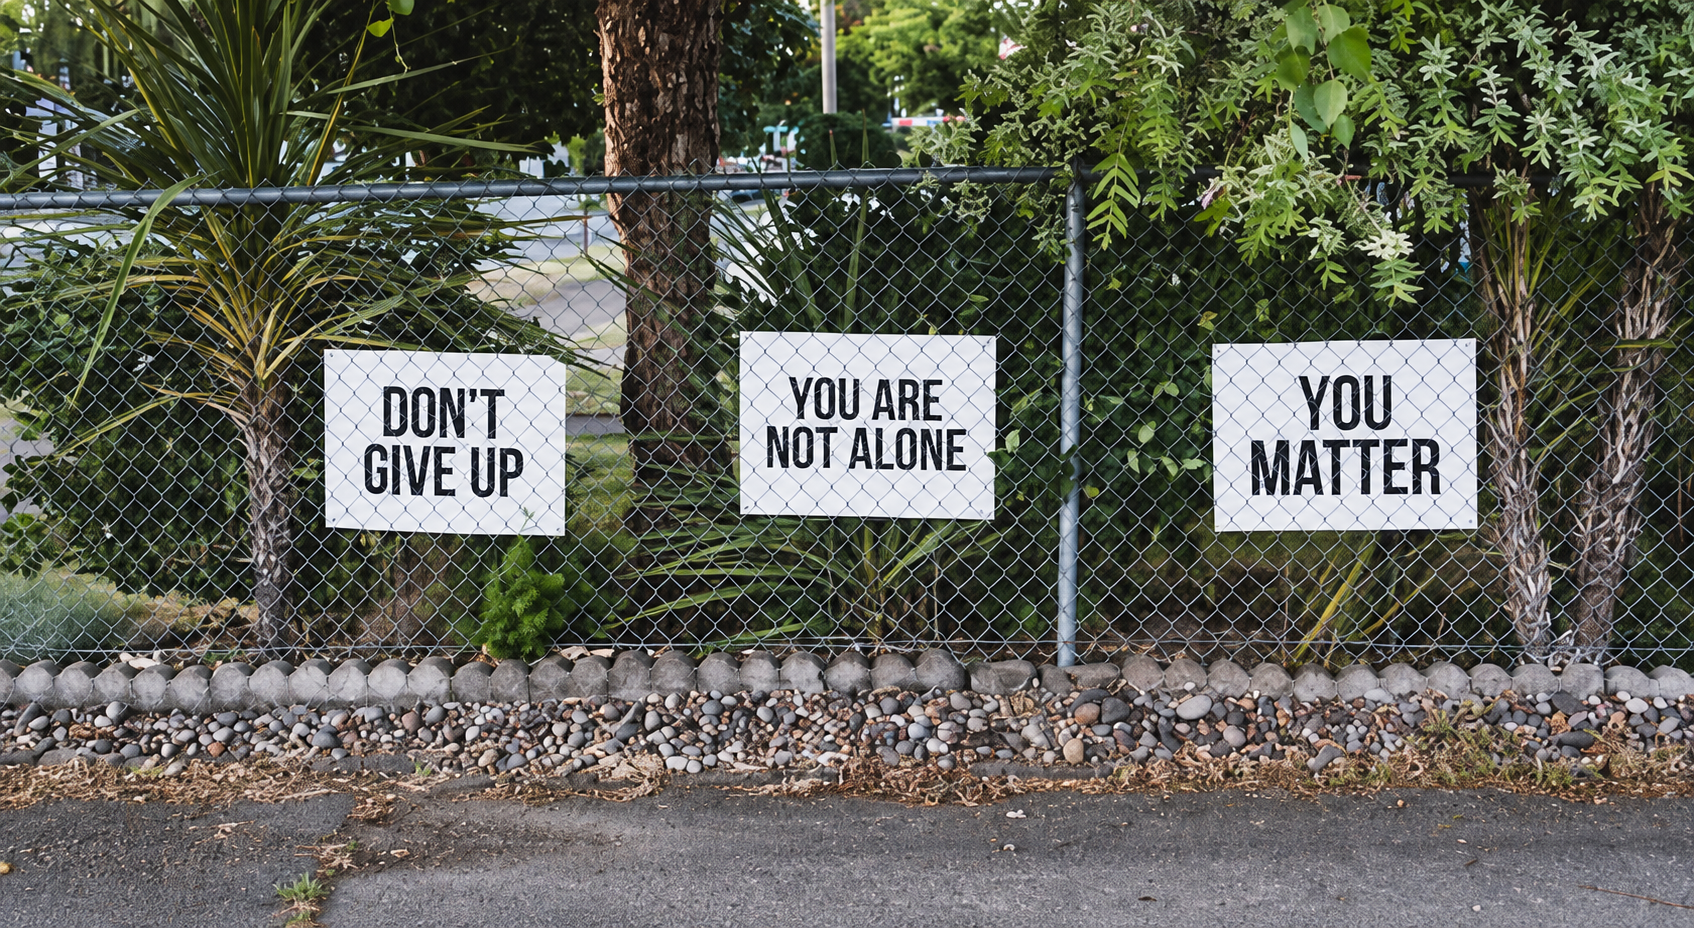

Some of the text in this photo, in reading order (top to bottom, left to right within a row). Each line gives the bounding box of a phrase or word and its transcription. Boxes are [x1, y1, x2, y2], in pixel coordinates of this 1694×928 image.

[383, 386, 505, 439] DON'T
[789, 377, 943, 421] YOU ARE
[1299, 374, 1392, 431] YOU
[364, 443, 524, 498] GIVE UP
[767, 426, 967, 471] NOT ALONE
[1251, 438, 1441, 496] MATTER
